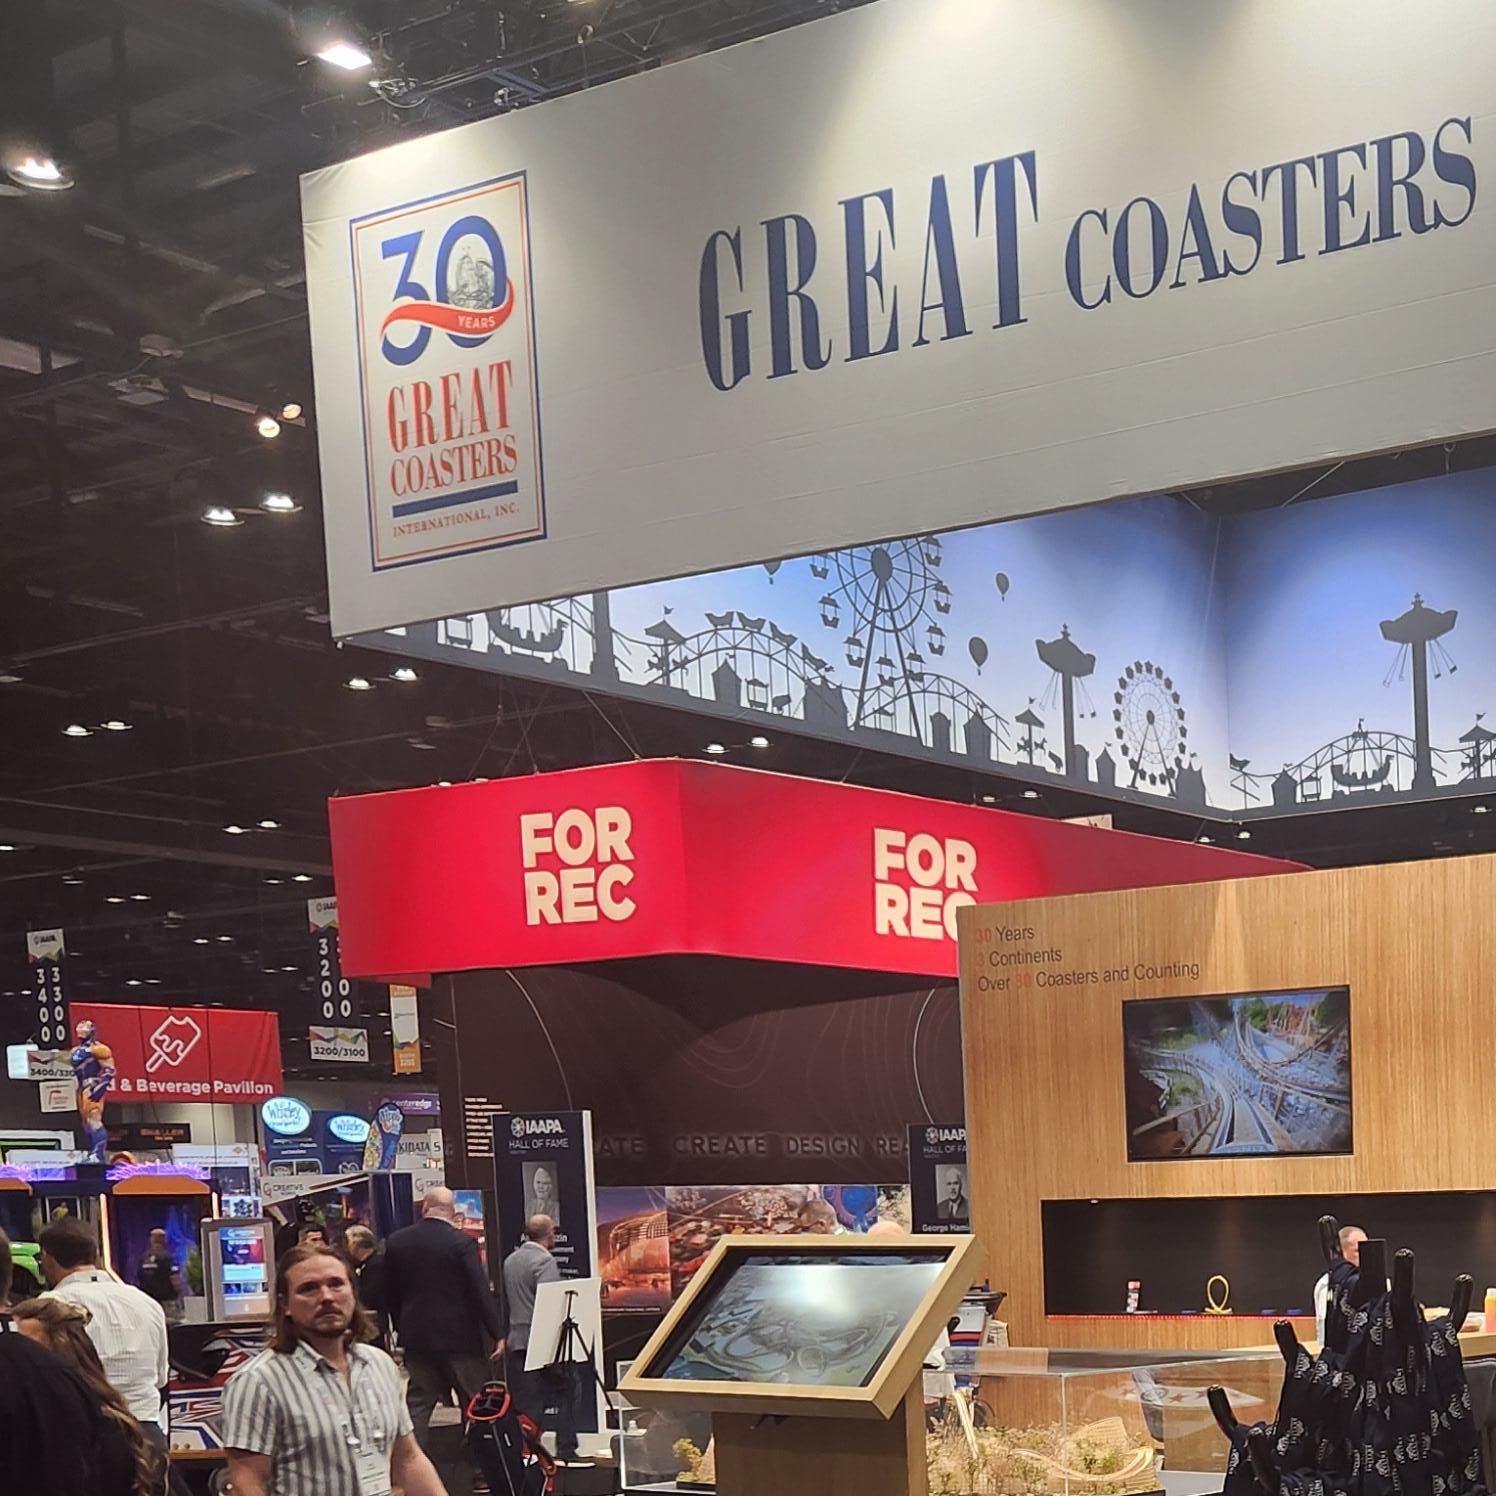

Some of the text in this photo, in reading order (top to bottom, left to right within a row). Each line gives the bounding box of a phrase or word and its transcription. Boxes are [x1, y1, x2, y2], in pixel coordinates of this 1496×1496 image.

[699, 117, 1476, 392] GREAT COASTERS
[381, 215, 508, 366] 30
[457, 316, 496, 329] YEARS
[387, 360, 512, 453] GREAT
[390, 434, 517, 496] COASTERS
[393, 502, 520, 537] INTERNATIONAL, INC.
[520, 806, 635, 868] FOR
[874, 828, 979, 892] FOR
[524, 864, 636, 925] REC
[976, 926, 1034, 944] 30 Years
[989, 947, 1062, 968] Continents
[978, 975, 1010, 992] Over
[1036, 970, 1098, 988] Coasters
[1104, 965, 1129, 983] and
[1134, 961, 1200, 981] Counting
[313, 1046, 366, 1057] 3200/3100
[120, 1078, 132, 1091] &
[136, 1079, 210, 1094] Beverage
[214, 1081, 273, 1095] Pavilion
[525, 1119, 564, 1134] IAAPA
[940, 1128, 967, 1141] IAAP
[509, 1138, 569, 1150] HALL OF FAME
[672, 1136, 767, 1155] CREATE
[786, 1136, 860, 1155] DESIGN
[923, 1145, 943, 1154] HALL
[945, 1145, 955, 1153] OF
[922, 1224, 949, 1233] George
